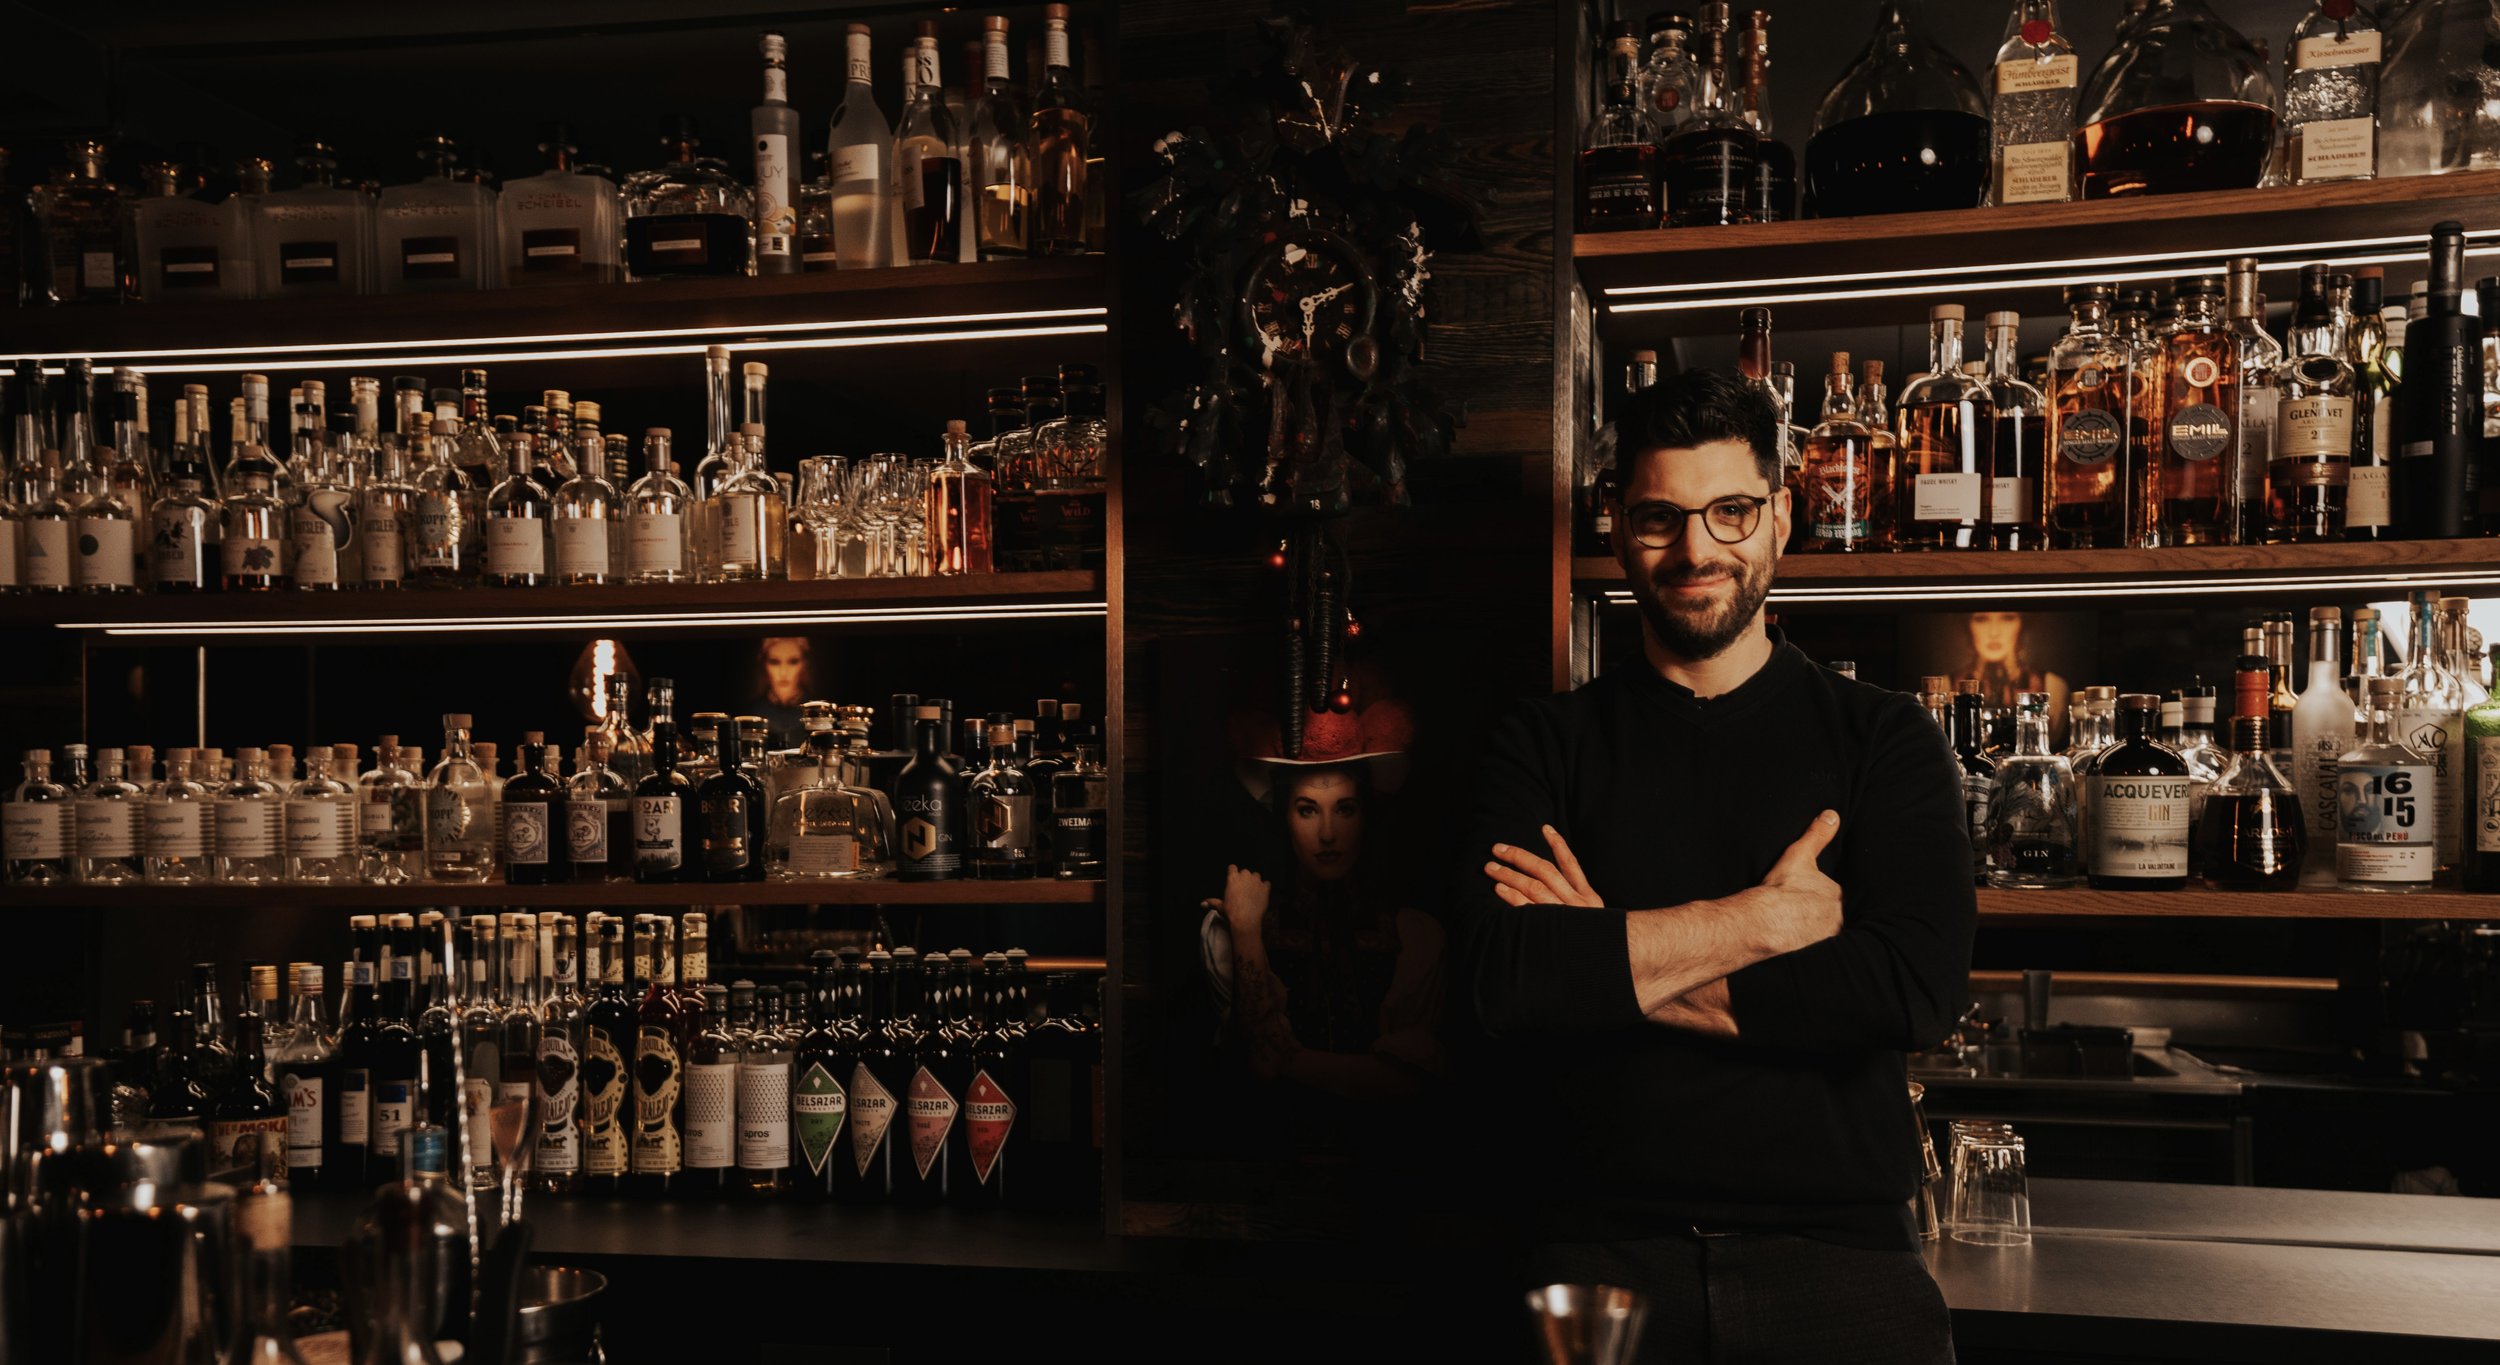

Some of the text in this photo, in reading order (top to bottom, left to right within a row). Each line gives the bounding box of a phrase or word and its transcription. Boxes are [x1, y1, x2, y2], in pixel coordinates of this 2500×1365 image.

[2290, 408, 2343, 420] GLENVET
[2373, 771, 2412, 795] 16
[2384, 797, 2416, 828] 15
[2023, 849, 2049, 858] GIN
[796, 1095, 842, 1107] BELSAZAR
[379, 1109, 401, 1121] 51
[966, 1104, 1009, 1115] BELSAZAR
[239, 1119, 288, 1134] MOKA
[744, 1129, 770, 1139] apros
